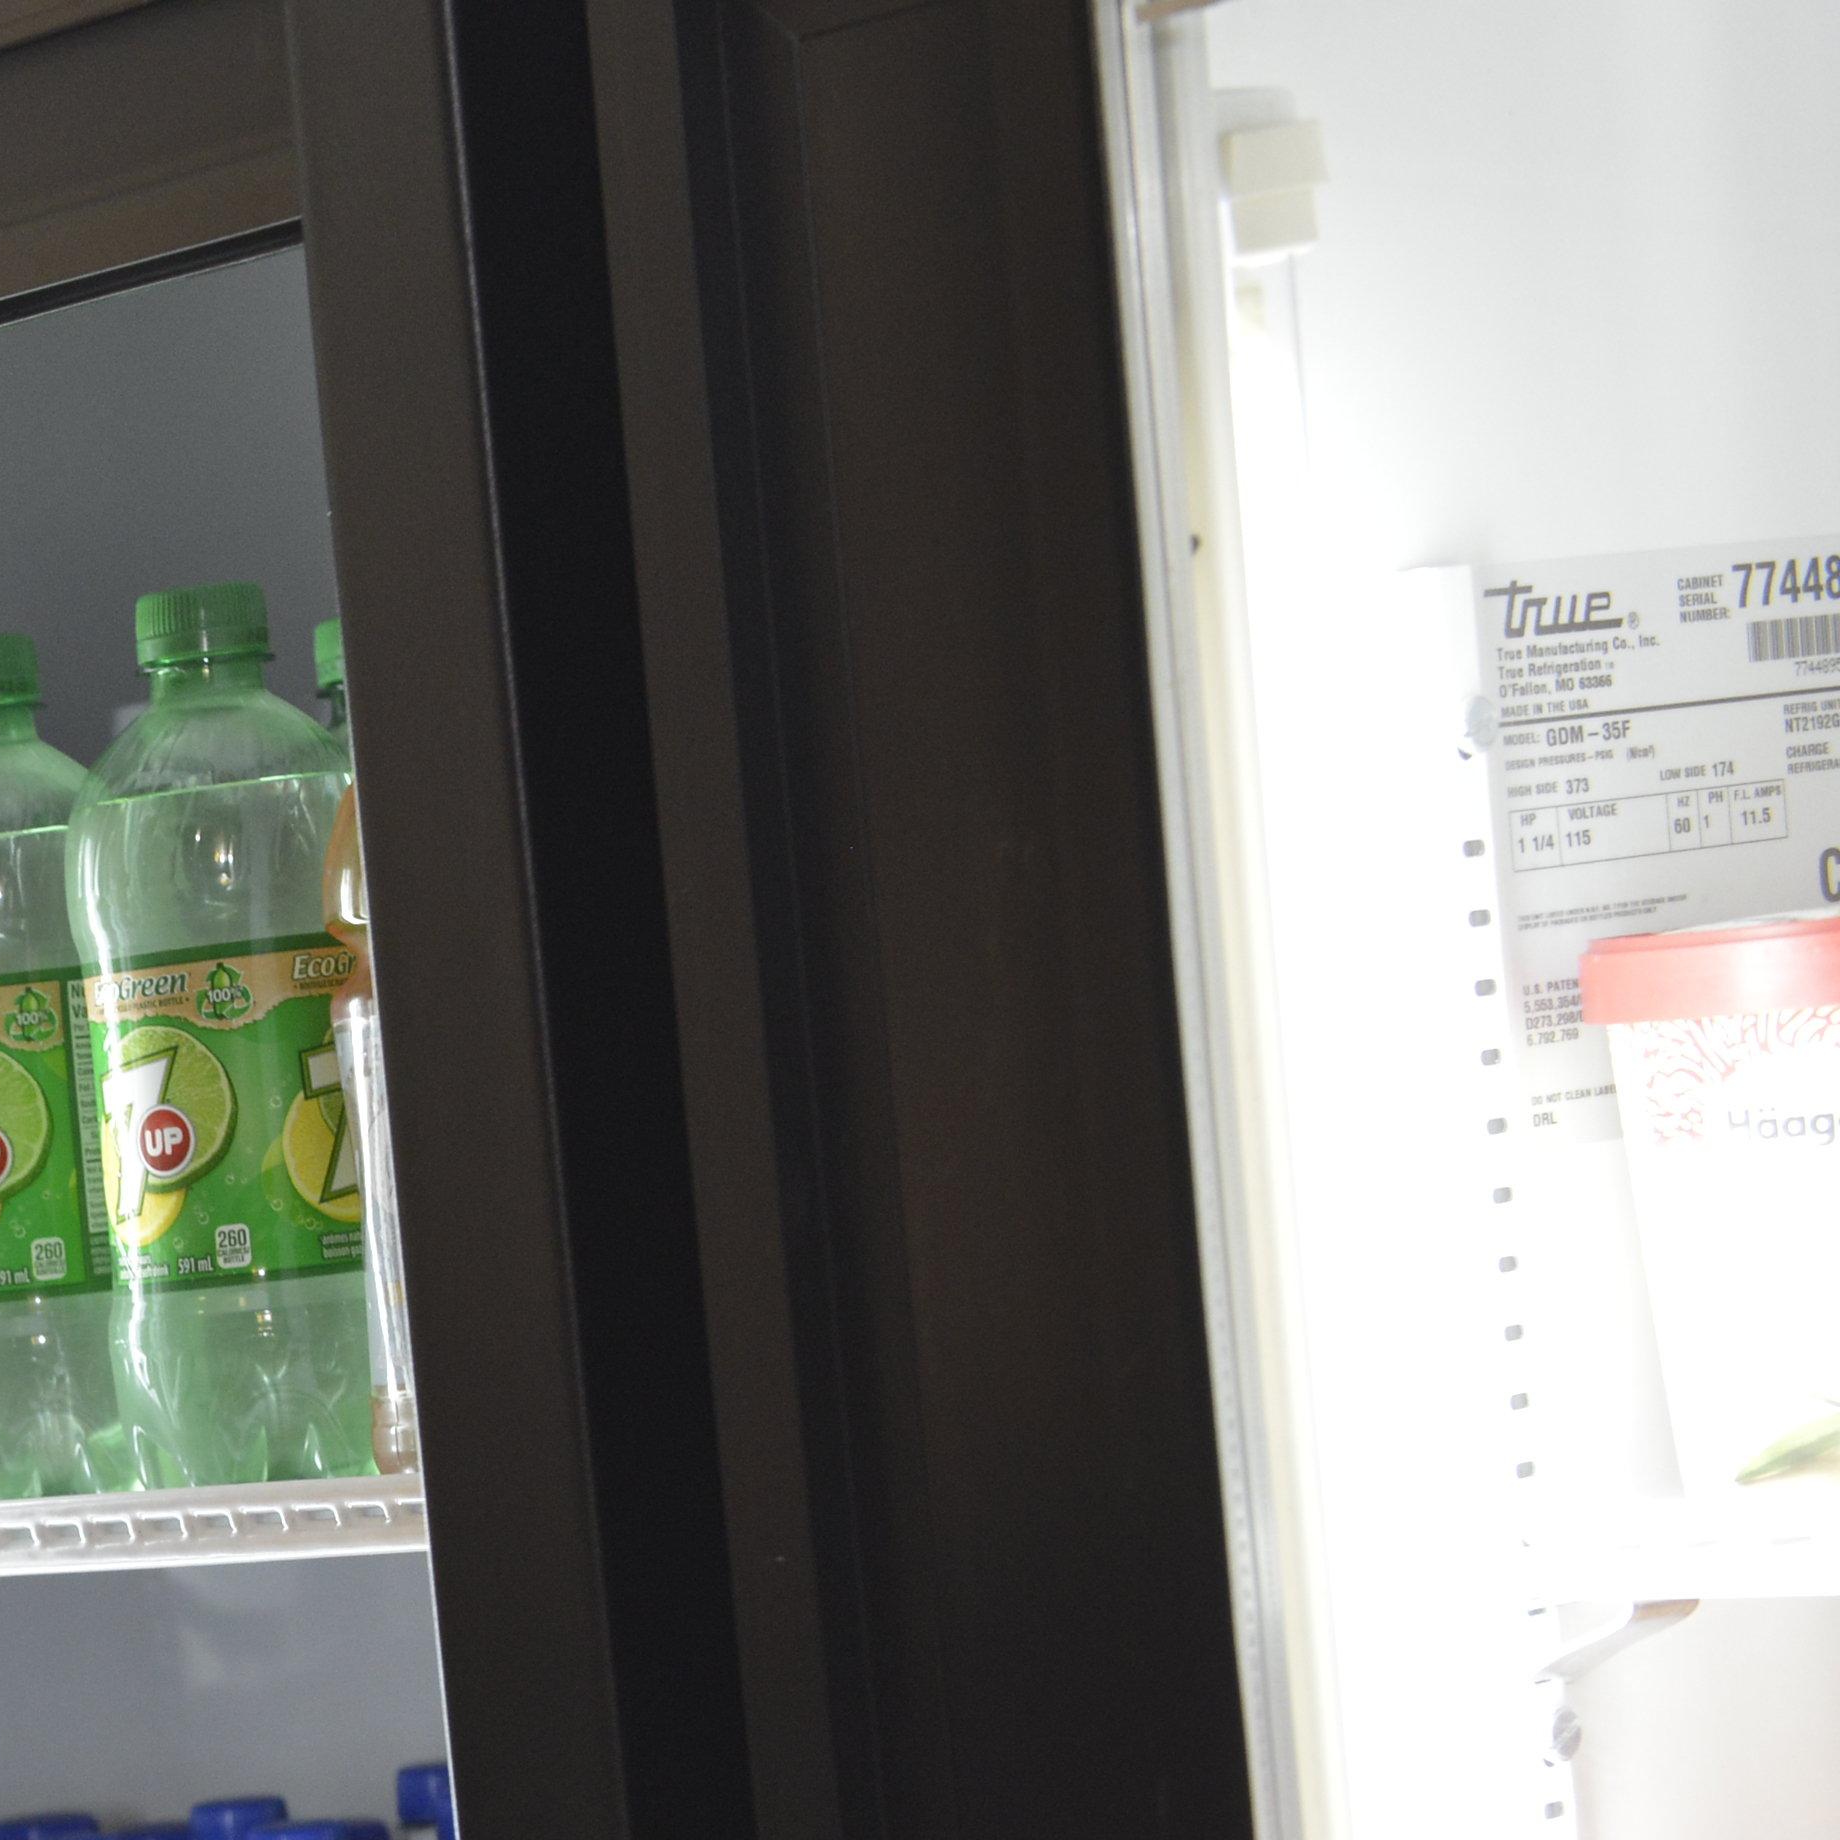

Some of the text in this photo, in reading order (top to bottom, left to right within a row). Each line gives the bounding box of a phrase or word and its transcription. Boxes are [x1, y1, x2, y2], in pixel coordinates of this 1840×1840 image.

[1677, 574, 1723, 590] CABINET
[1732, 554, 1840, 608] 77448
[1679, 592, 1717, 607] SERIAL
[1484, 580, 1623, 638] true
[1680, 607, 1730, 623] NUMBER:
[1497, 648, 1522, 661] True
[1526, 640, 1608, 657] Manufacturing
[1498, 666, 1523, 679] True
[1528, 660, 1601, 677] Refrigeration
[1555, 678, 1575, 691] MO
[1501, 699, 1589, 718] MADE IN THE USA
[1786, 742, 1830, 759] CHARGE
[1660, 761, 1734, 781] LOW SIDE 174
[1507, 778, 1590, 798] HIGH SIDE 373
[1754, 785, 1782, 798] AMPS
[1677, 796, 1690, 807] HZ
[1708, 791, 1723, 803] PH
[1520, 814, 1536, 826] HP
[1568, 803, 1617, 820] VOLTAGE
[1741, 807, 1771, 825] 11.5
[1673, 818, 1691, 834] 60
[1532, 834, 1555, 851] 1/4
[1565, 830, 1591, 847] 115
[1547, 979, 1580, 992] PATEN
[1546, 1092, 1561, 1103] NOT
[1565, 1087, 1592, 1101] CLEAN
[1594, 1083, 1616, 1096] LABE
[218, 1229, 247, 1248] 260
[34, 1243, 63, 1260] 260
[178, 1257, 195, 1275] 591
